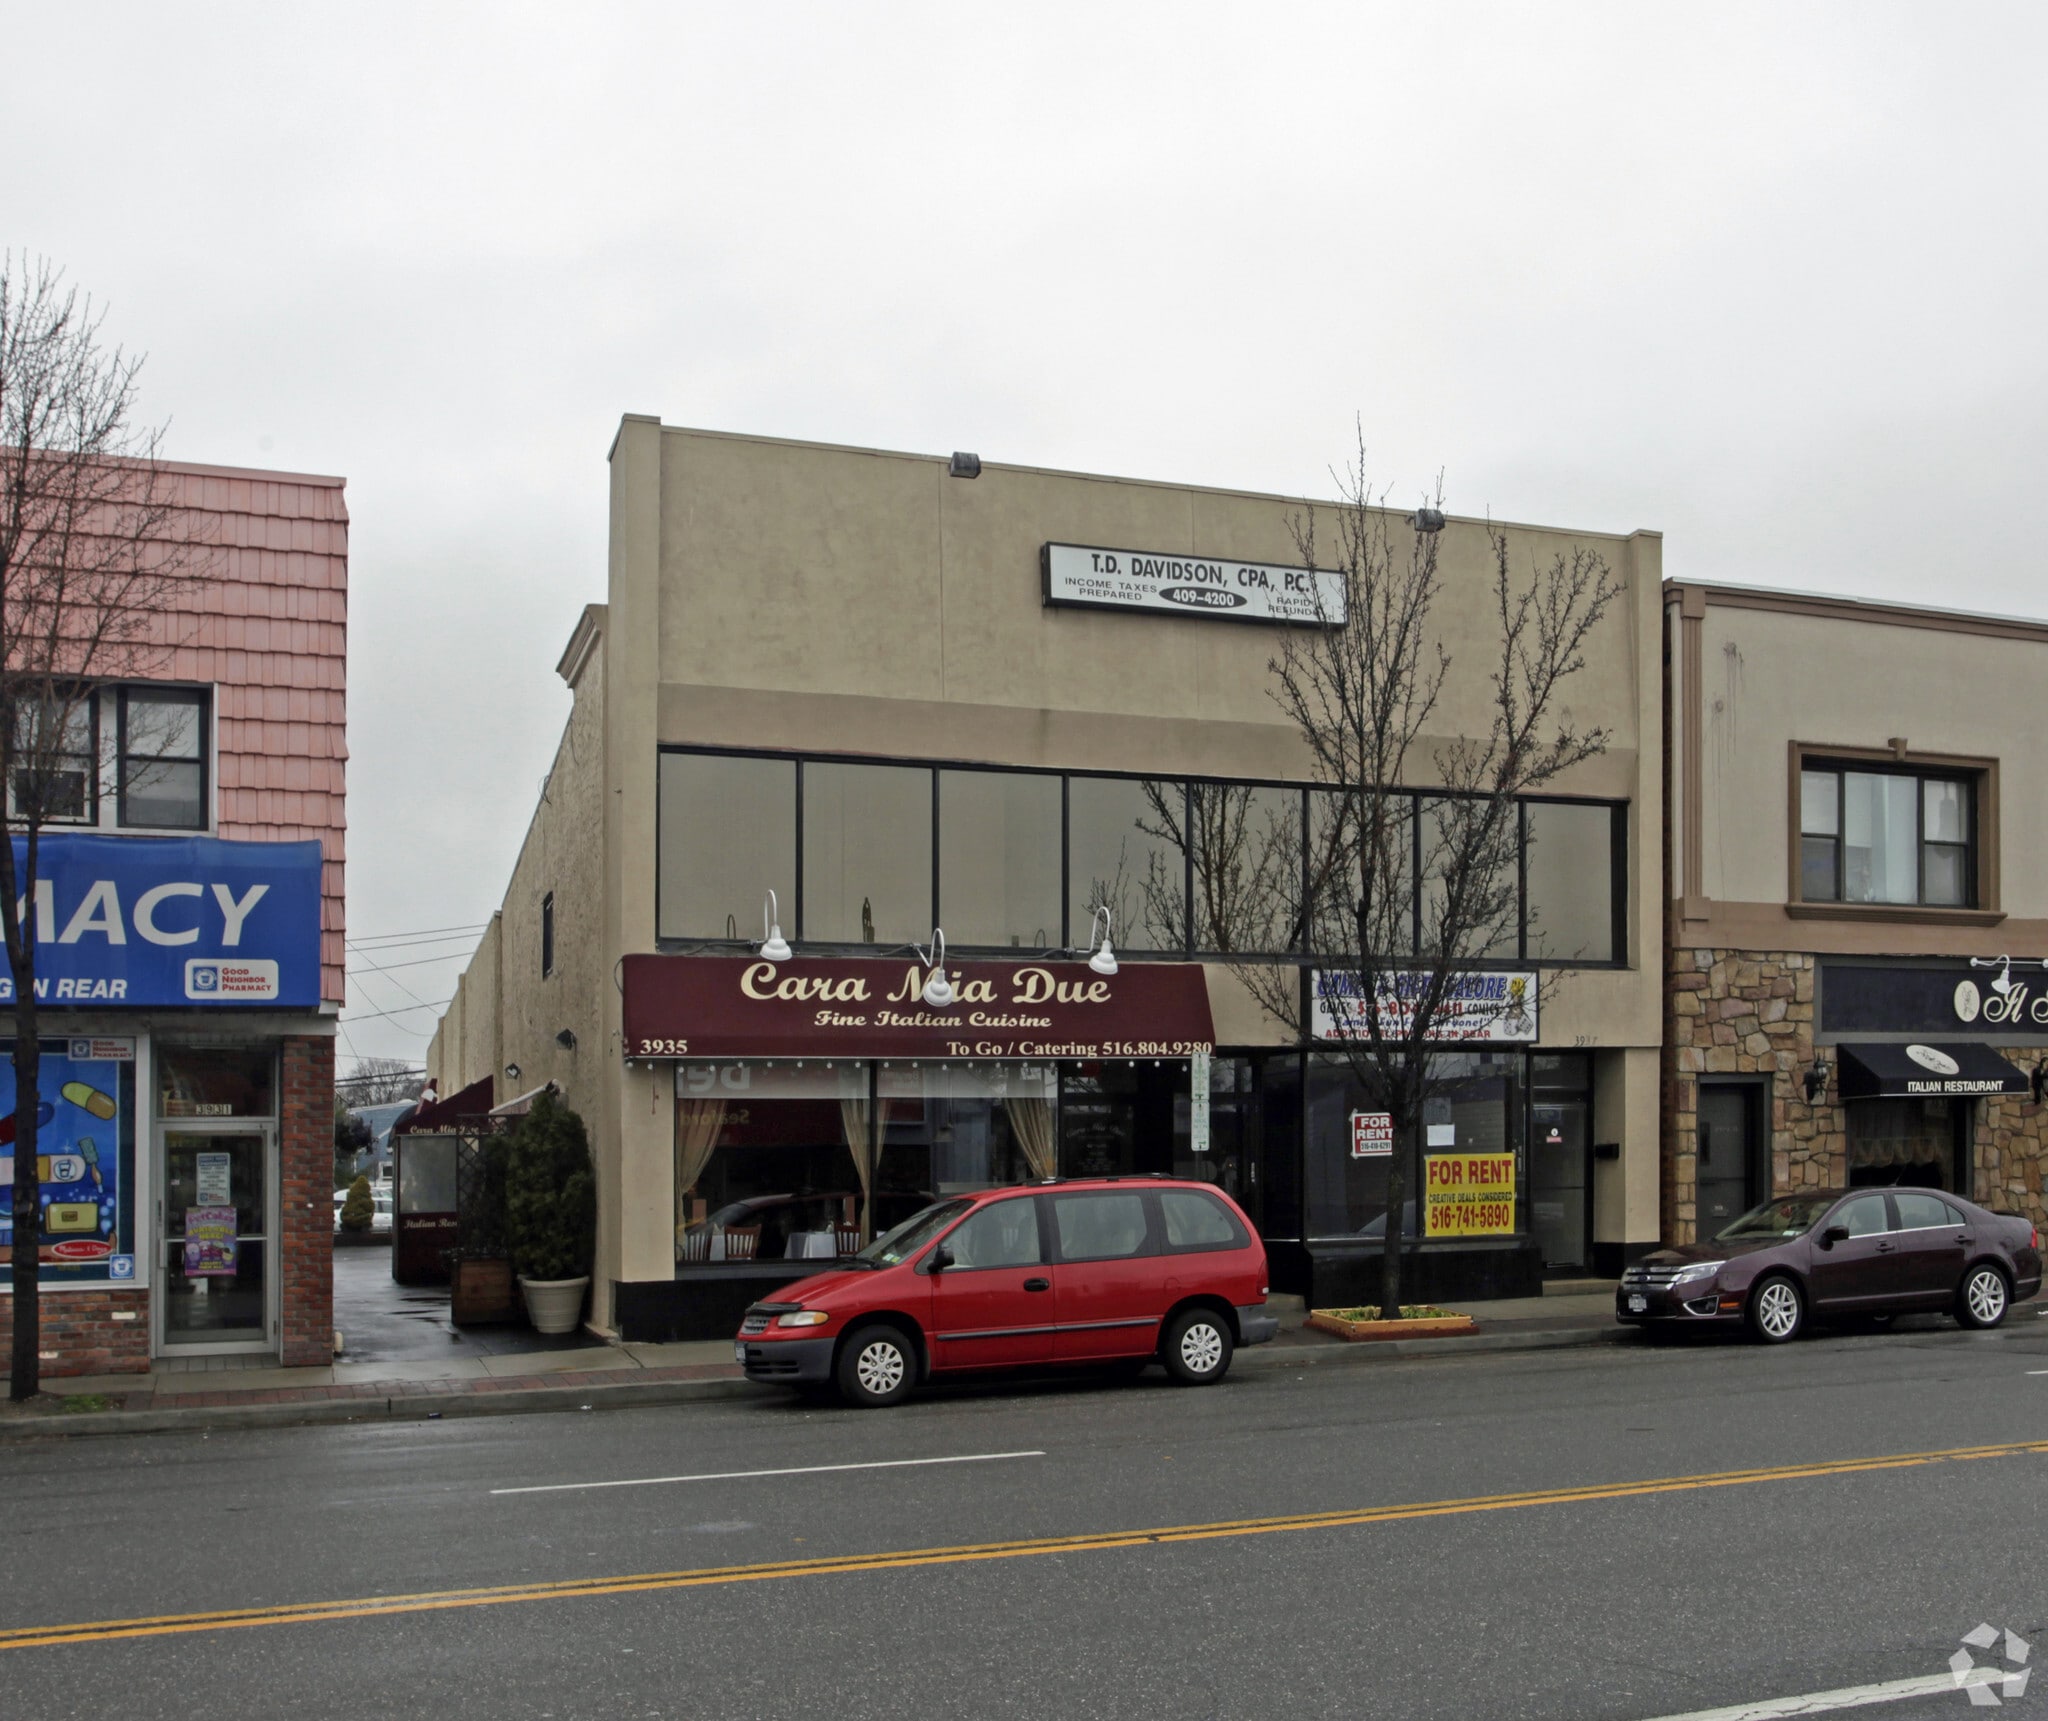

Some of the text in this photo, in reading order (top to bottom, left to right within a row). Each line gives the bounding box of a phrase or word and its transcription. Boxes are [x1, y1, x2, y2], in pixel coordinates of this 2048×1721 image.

[1092, 554, 1310, 593] T.D. DAVIDSON, CPA, P.C.
[1065, 577, 1157, 594] INCOME TAXES
[1079, 588, 1142, 601] PREPARED
[1172, 589, 1235, 607] 409-4200
[1277, 597, 1311, 607] RAPID
[57, 978, 127, 999] REAR
[740, 963, 871, 1002] Cara
[1011, 967, 1112, 1003] Due
[814, 1010, 1052, 1027] Fine Italian Cuisine
[640, 1039, 688, 1054] 3935
[947, 1042, 970, 1055] To
[975, 1042, 1002, 1055] Go
[1018, 1041, 1097, 1058] Catering
[1102, 1041, 1212, 1056] 516.804.9280
[1908, 1080, 2004, 1092] ITALIAN RESTAURANT
[196, 1104, 232, 1115] 3931
[410, 1125, 433, 1134] Cara
[1361, 1117, 1390, 1128] FOR
[1356, 1128, 1393, 1139] RENT
[1429, 1160, 1512, 1185] FOR RENT
[1429, 1191, 1512, 1203] CREATIVE DEALS CONSIDERED
[1432, 1204, 1509, 1230] 516-741-5890
